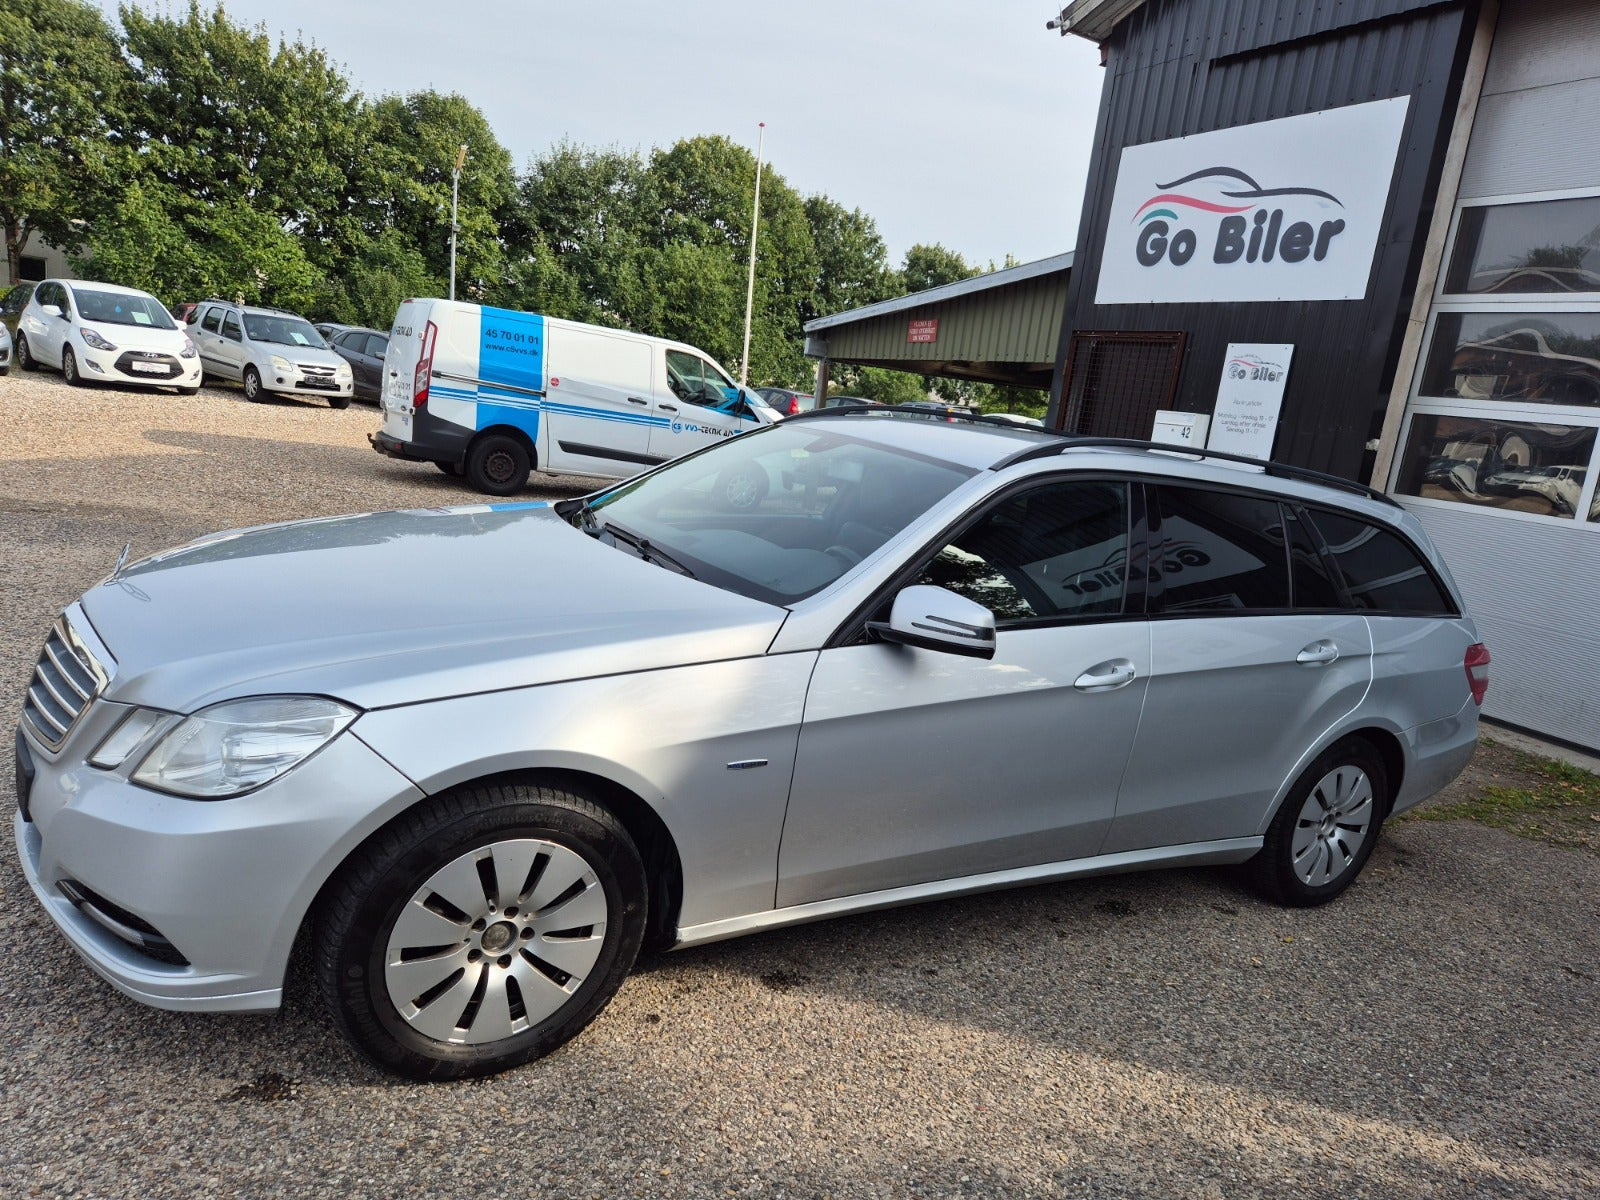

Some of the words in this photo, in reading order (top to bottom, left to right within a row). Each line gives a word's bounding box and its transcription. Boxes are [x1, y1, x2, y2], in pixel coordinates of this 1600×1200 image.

[1135, 219, 1197, 267] Go
[1212, 208, 1346, 264] Biler
[485, 329, 498, 339] 45
[500, 330, 512, 341] 70
[513, 333, 525, 343] 01
[528, 335, 539, 345] 01
[485, 343, 538, 356] www.c5vvs.dk
[1228, 366, 1246, 380] Go
[1250, 366, 1284, 382] Biler
[1181, 426, 1191, 439] 42
